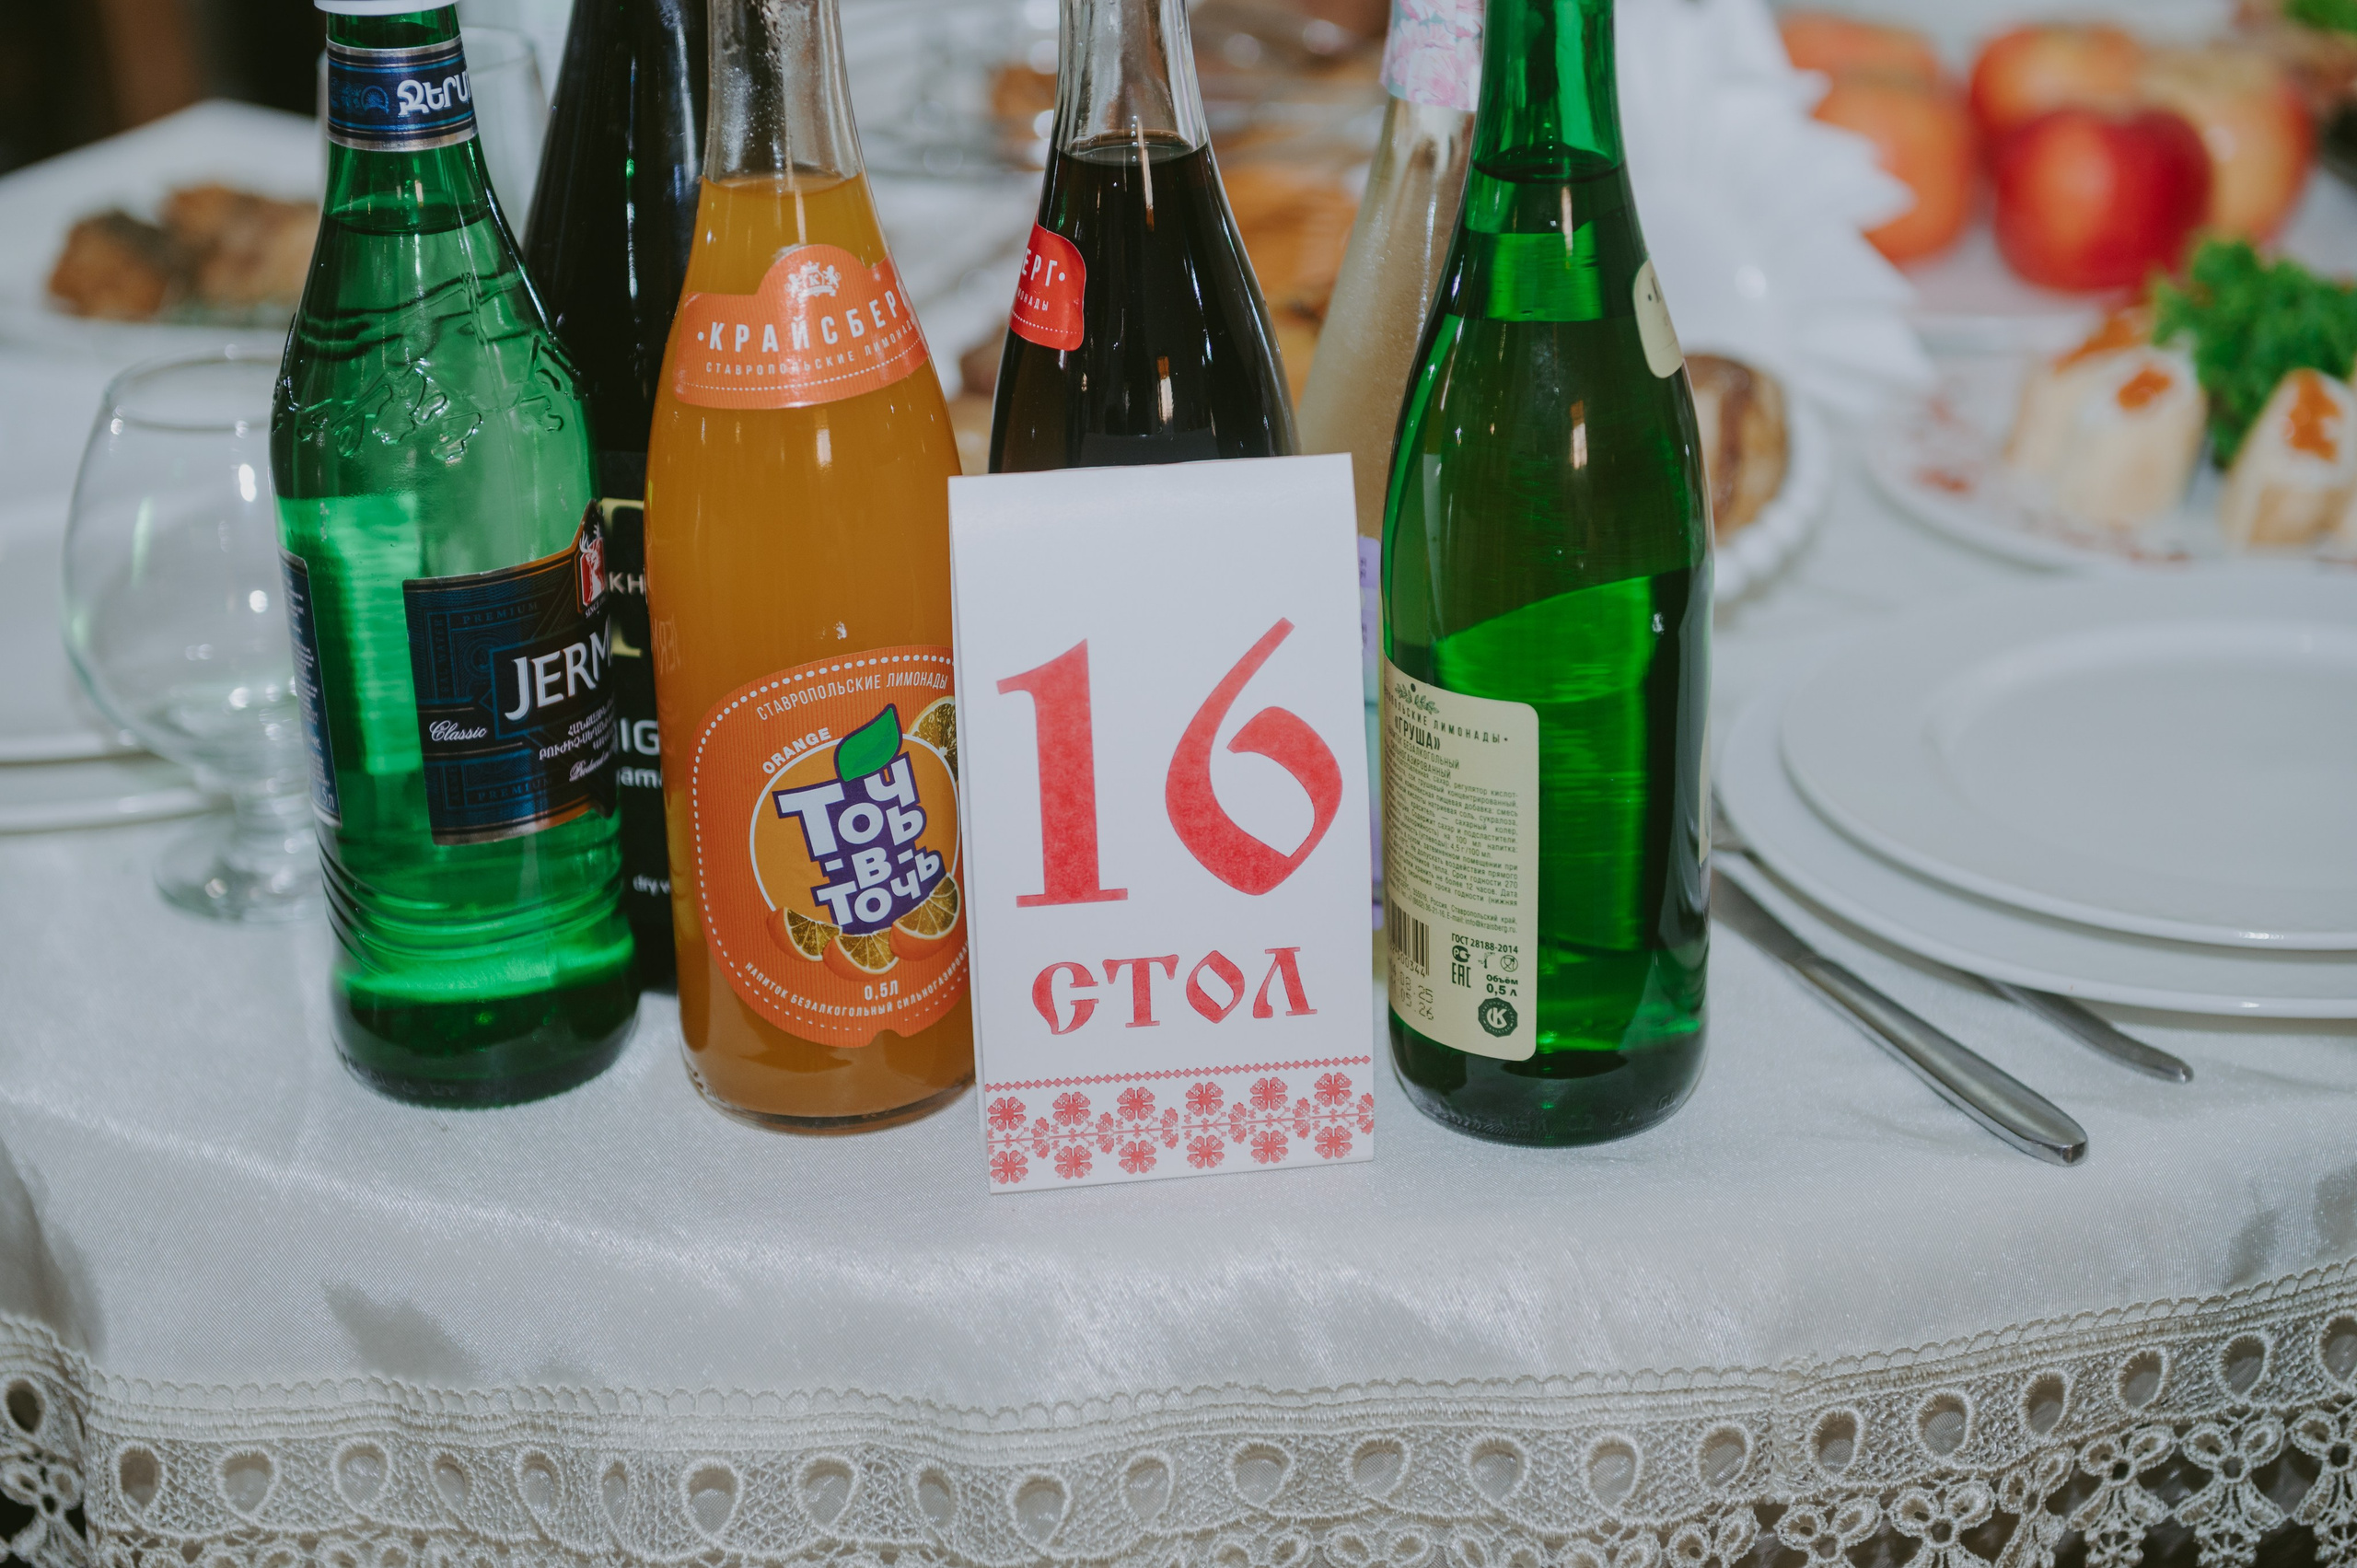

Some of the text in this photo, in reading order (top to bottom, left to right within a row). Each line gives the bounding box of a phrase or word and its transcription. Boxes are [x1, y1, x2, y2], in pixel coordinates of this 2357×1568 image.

[706, 316, 914, 376] СТАВРОПОЛЬСКИЕ ЛИМОНАД
[462, 602, 538, 624] PREMIUM
[505, 615, 611, 722] JERM
[756, 671, 948, 721] СТАВРОПОЛЬСКИЕ ЛИМОНАДЫ
[429, 719, 487, 742] Classic
[1394, 714, 1440, 751] «ГРУША»
[1433, 719, 1500, 744] ЛИМОНАДЫ
[762, 727, 831, 774] ORANGE
[996, 616, 1343, 909] 16
[1454, 783, 1487, 796] регулятор
[1437, 822, 1454, 833] сахар
[1455, 819, 1487, 831] сахарный
[1456, 835, 1467, 844] 100
[1487, 843, 1518, 853] напитка:
[1445, 860, 1485, 876] воздействия
[1488, 871, 1517, 879] прямого
[1462, 856, 1502, 869] помещении
[1445, 877, 1462, 888] более
[1500, 889, 1517, 898] Дата
[1452, 869, 1467, 881] Срок
[1469, 876, 1501, 887] годности
[1434, 882, 1450, 894] срока
[1454, 889, 1483, 902] годности
[1452, 933, 1518, 954] ГОСТ 28188-2014
[745, 962, 787, 998] НАПИТОК
[790, 994, 893, 1017] БЕЗАЛКОГОЛЬНЫЙ
[864, 980, 899, 1001] 0,5Л
[1032, 947, 1318, 1035] СТОЛ
[1486, 983, 1506, 996] 0,5
